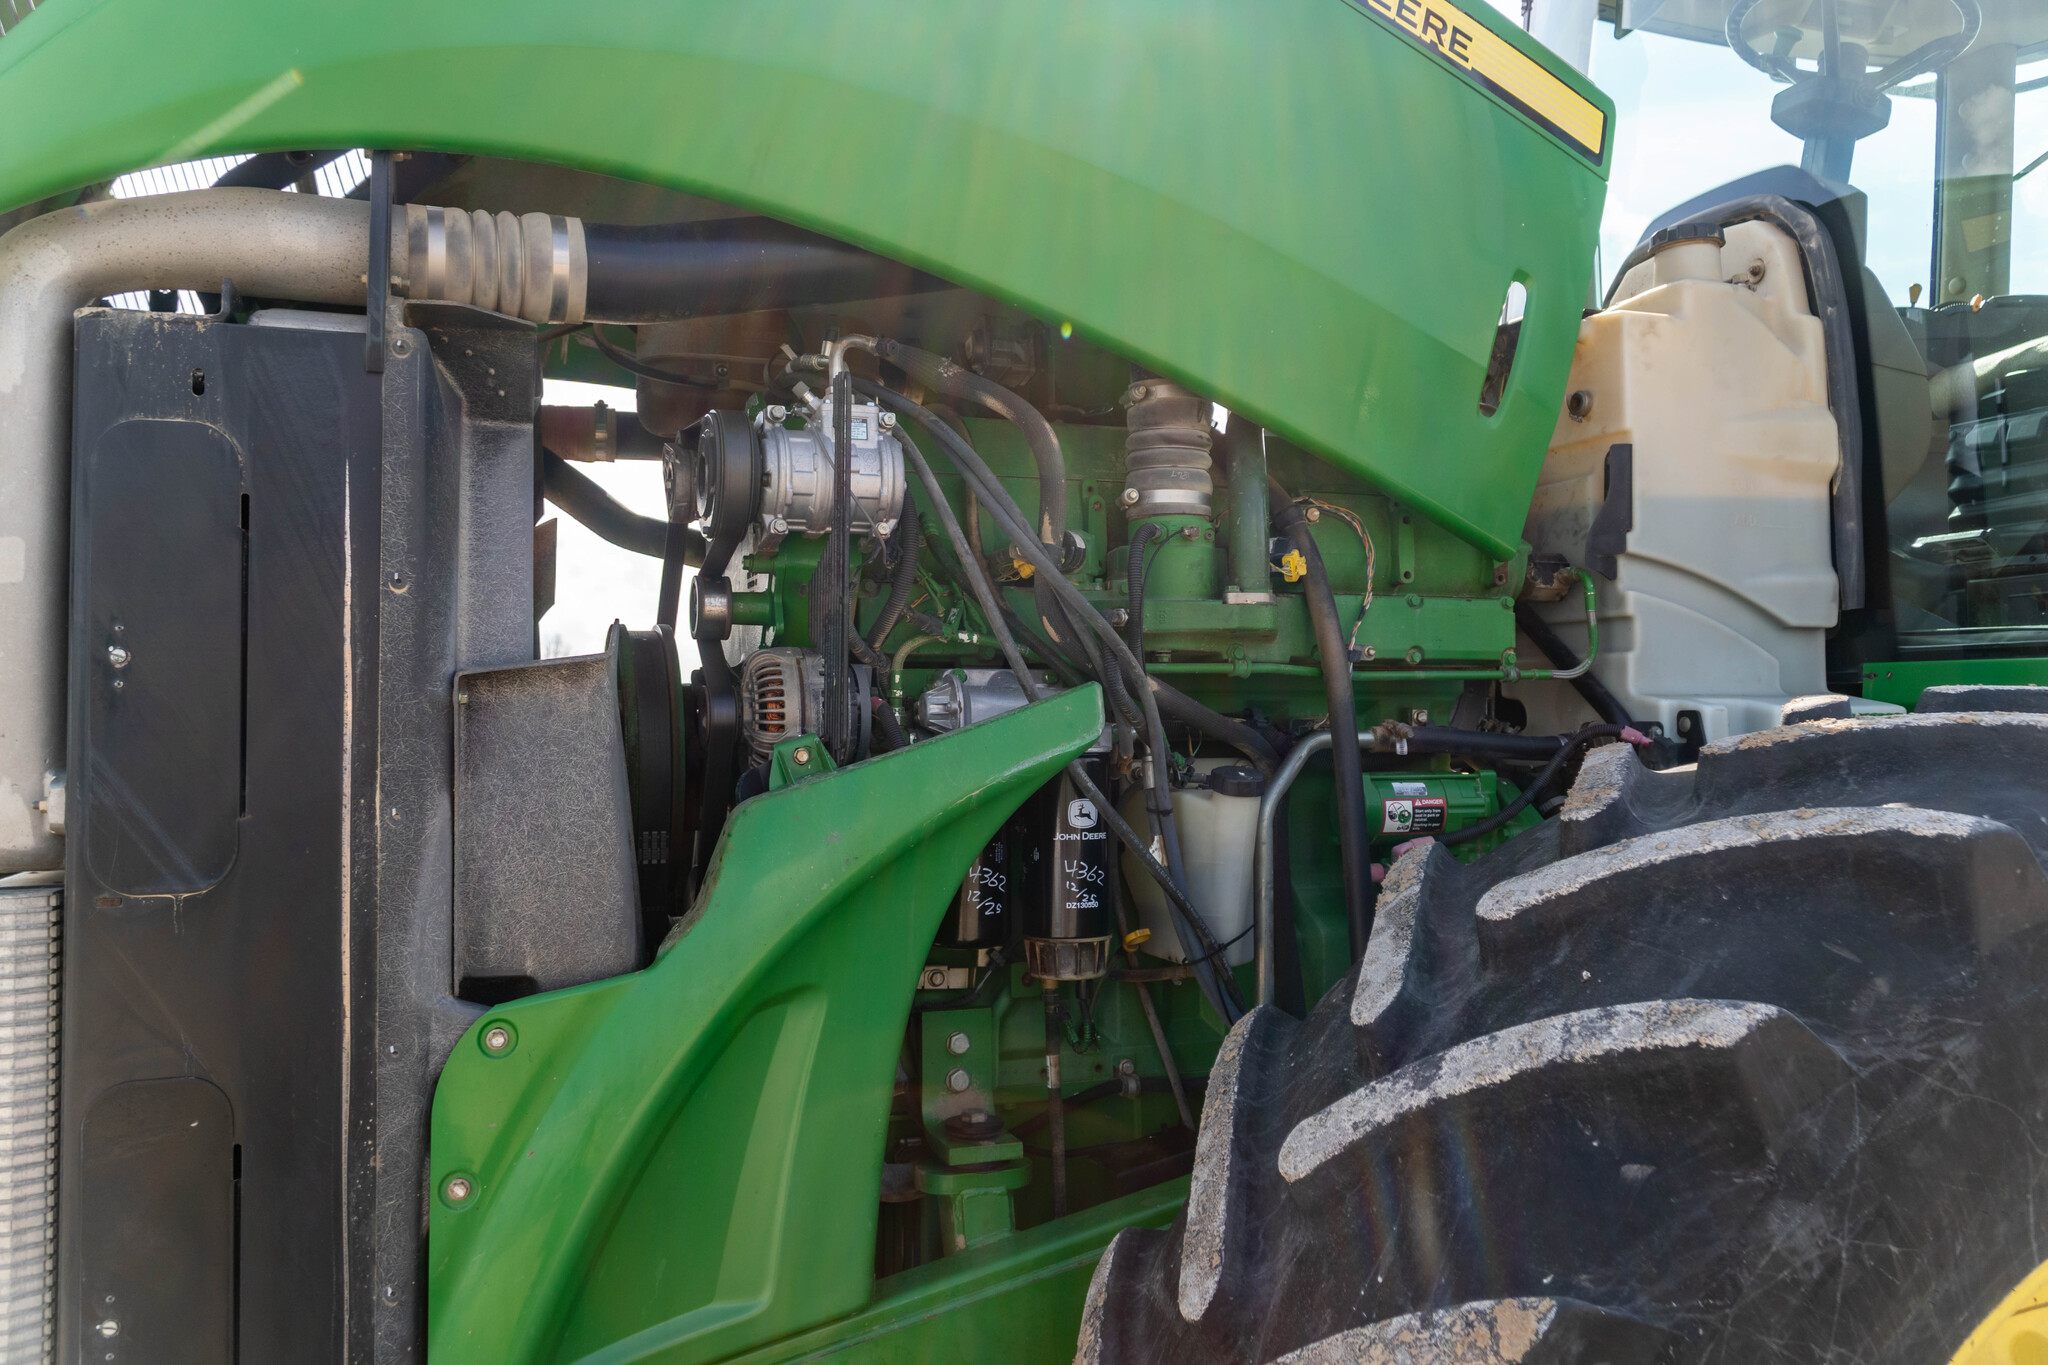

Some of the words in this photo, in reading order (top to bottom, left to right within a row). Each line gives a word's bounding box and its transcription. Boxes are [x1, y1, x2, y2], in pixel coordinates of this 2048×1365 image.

[1053, 832, 1080, 840] JOHN
[1081, 832, 1107, 840] DEERE
[969, 865, 1007, 893] 4362
[1064, 860, 1105, 886] 4362
